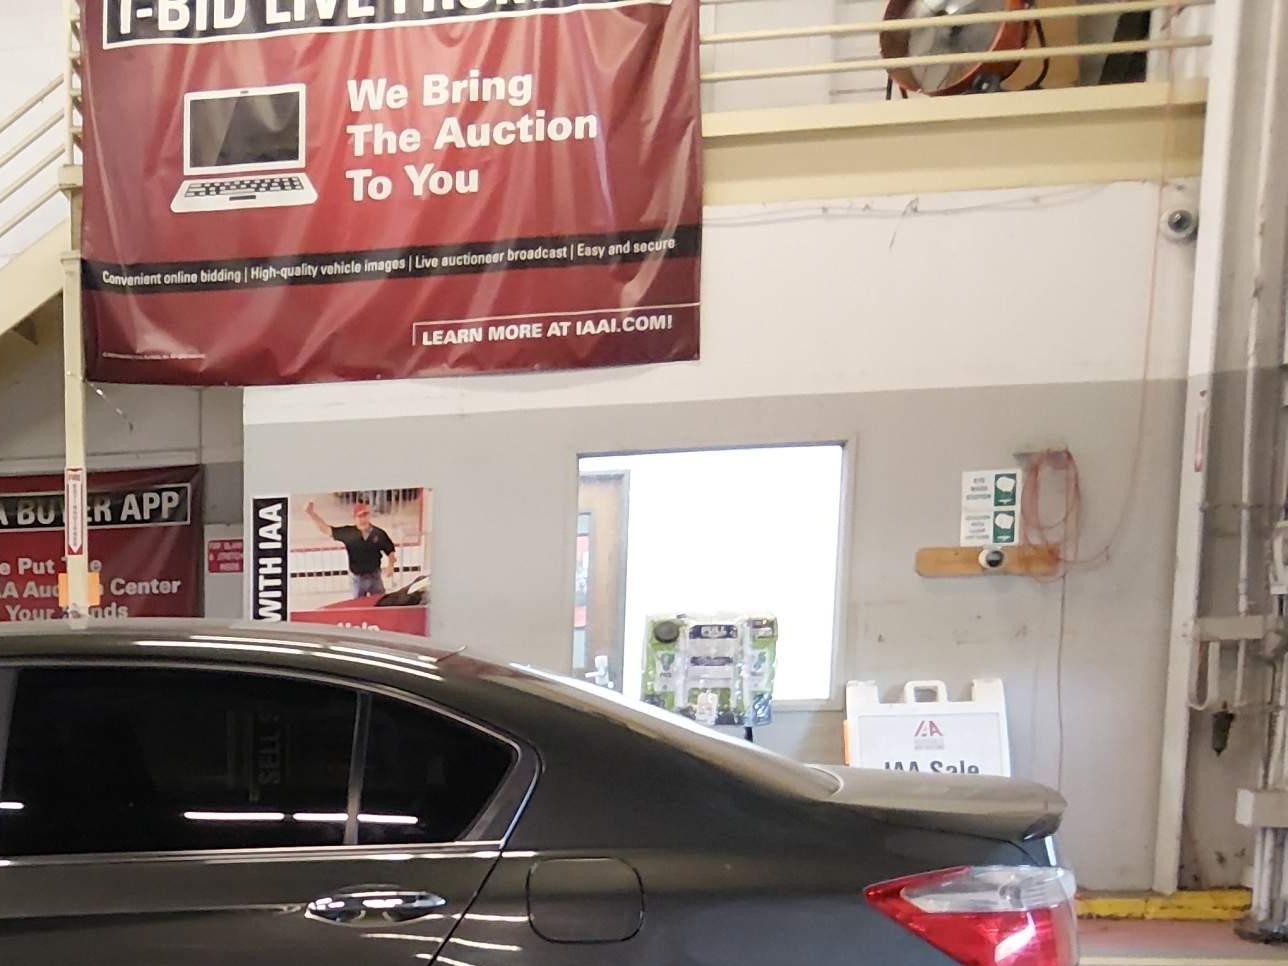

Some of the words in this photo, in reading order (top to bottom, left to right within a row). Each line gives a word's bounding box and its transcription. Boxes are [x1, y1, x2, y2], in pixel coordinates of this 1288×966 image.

[347, 78, 408, 112] We
[423, 69, 532, 106] Bring
[346, 123, 420, 156] The
[434, 109, 597, 150] Auction
[345, 169, 392, 201] To
[403, 163, 479, 196] You
[102, 270, 161, 287] Convenient
[164, 270, 197, 284] online
[200, 268, 241, 284] bidding
[251, 264, 318, 283] High-quality
[320, 262, 361, 276] vehicle
[364, 258, 406, 273] images
[415, 254, 438, 269] Live
[441, 249, 504, 267] auctioneer
[507, 245, 567, 263] broadcast
[577, 242, 605, 259] Easy
[608, 239, 631, 255] and
[633, 237, 675, 254] secure
[422, 329, 482, 346] LEARN
[488, 323, 543, 342] MORE
[546, 321, 572, 338] AT
[576, 314, 673, 336] IAAI.COM!
[17, 495, 112, 526] BUR
[120, 490, 180, 522] APP
[258, 503, 282, 549] IAA
[18, 557, 55, 575] Put
[110, 577, 181, 596] Center
[258, 557, 282, 622] WITH
[5, 603, 54, 622] Your
